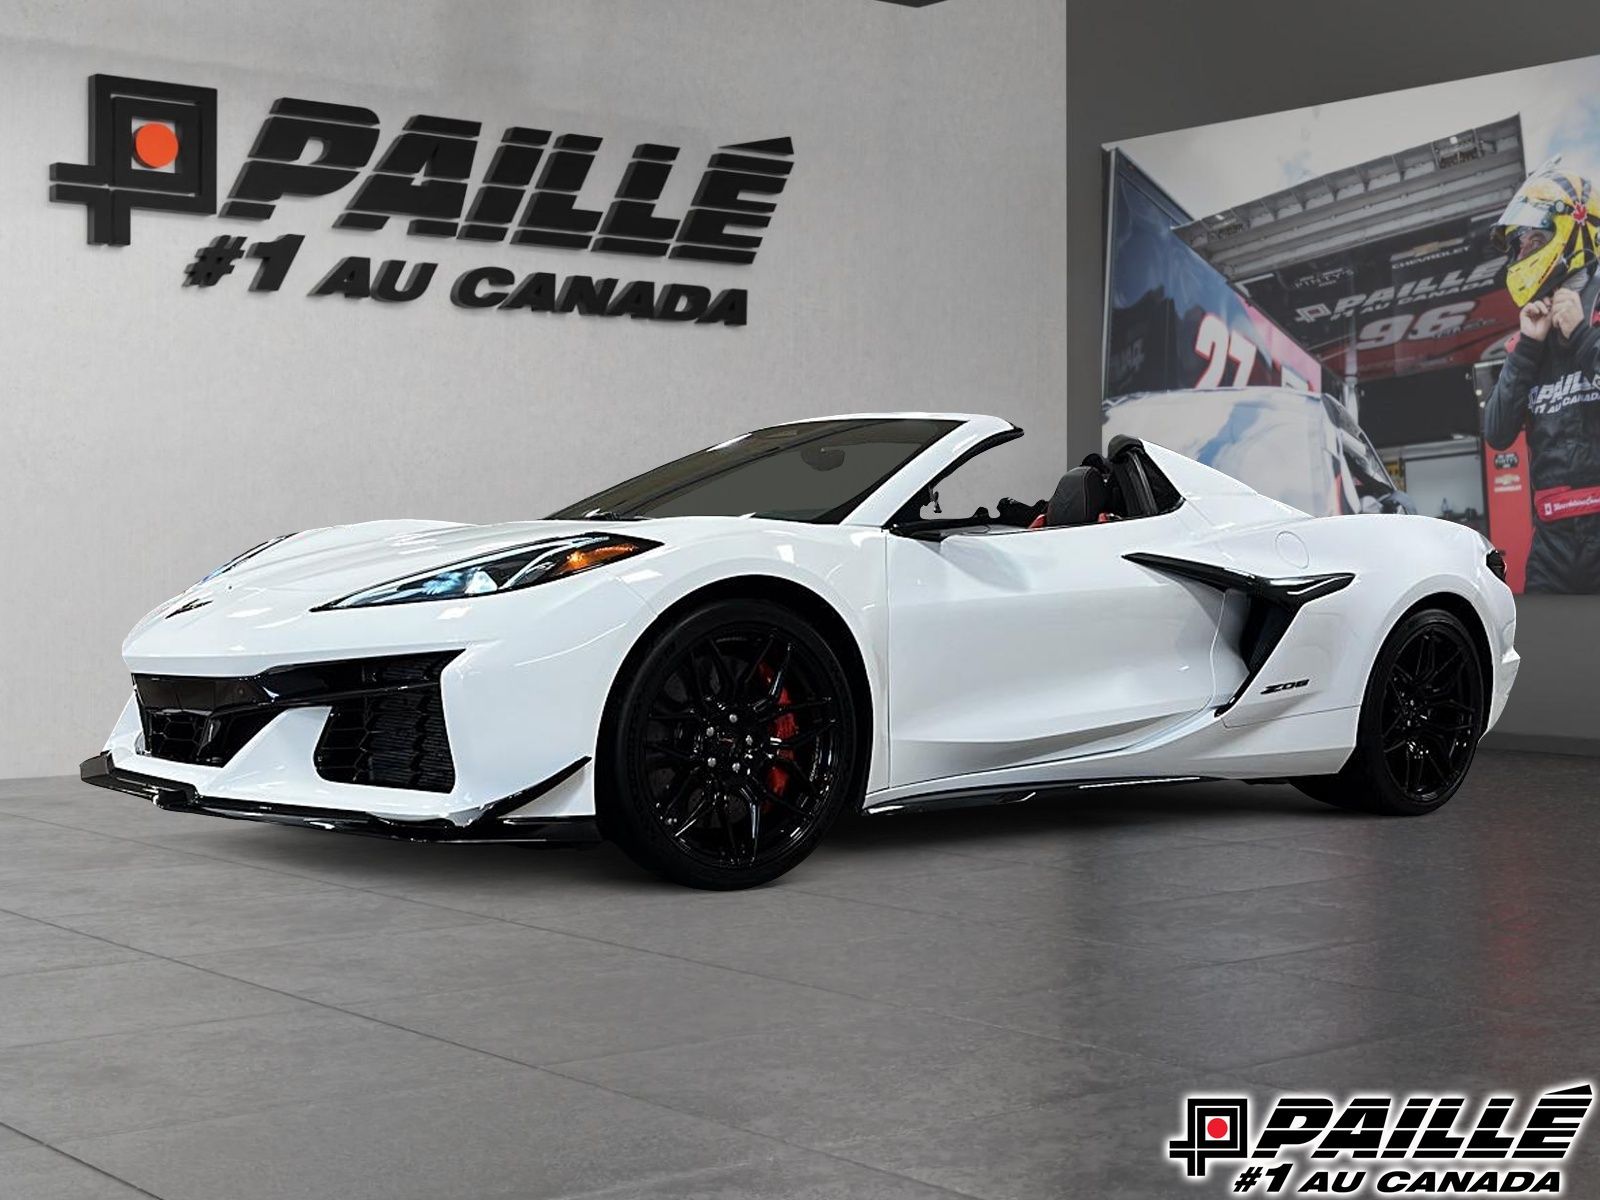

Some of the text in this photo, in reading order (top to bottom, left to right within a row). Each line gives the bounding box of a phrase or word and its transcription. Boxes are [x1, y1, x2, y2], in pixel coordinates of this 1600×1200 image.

[218, 97, 795, 265] PAILLÉ
[182, 233, 748, 326] #1 AU CANADA
[1360, 302, 1391, 314] AU
[1398, 278, 1494, 306] CANADA
[1194, 312, 1257, 391] 27
[1355, 301, 1477, 351] 96
